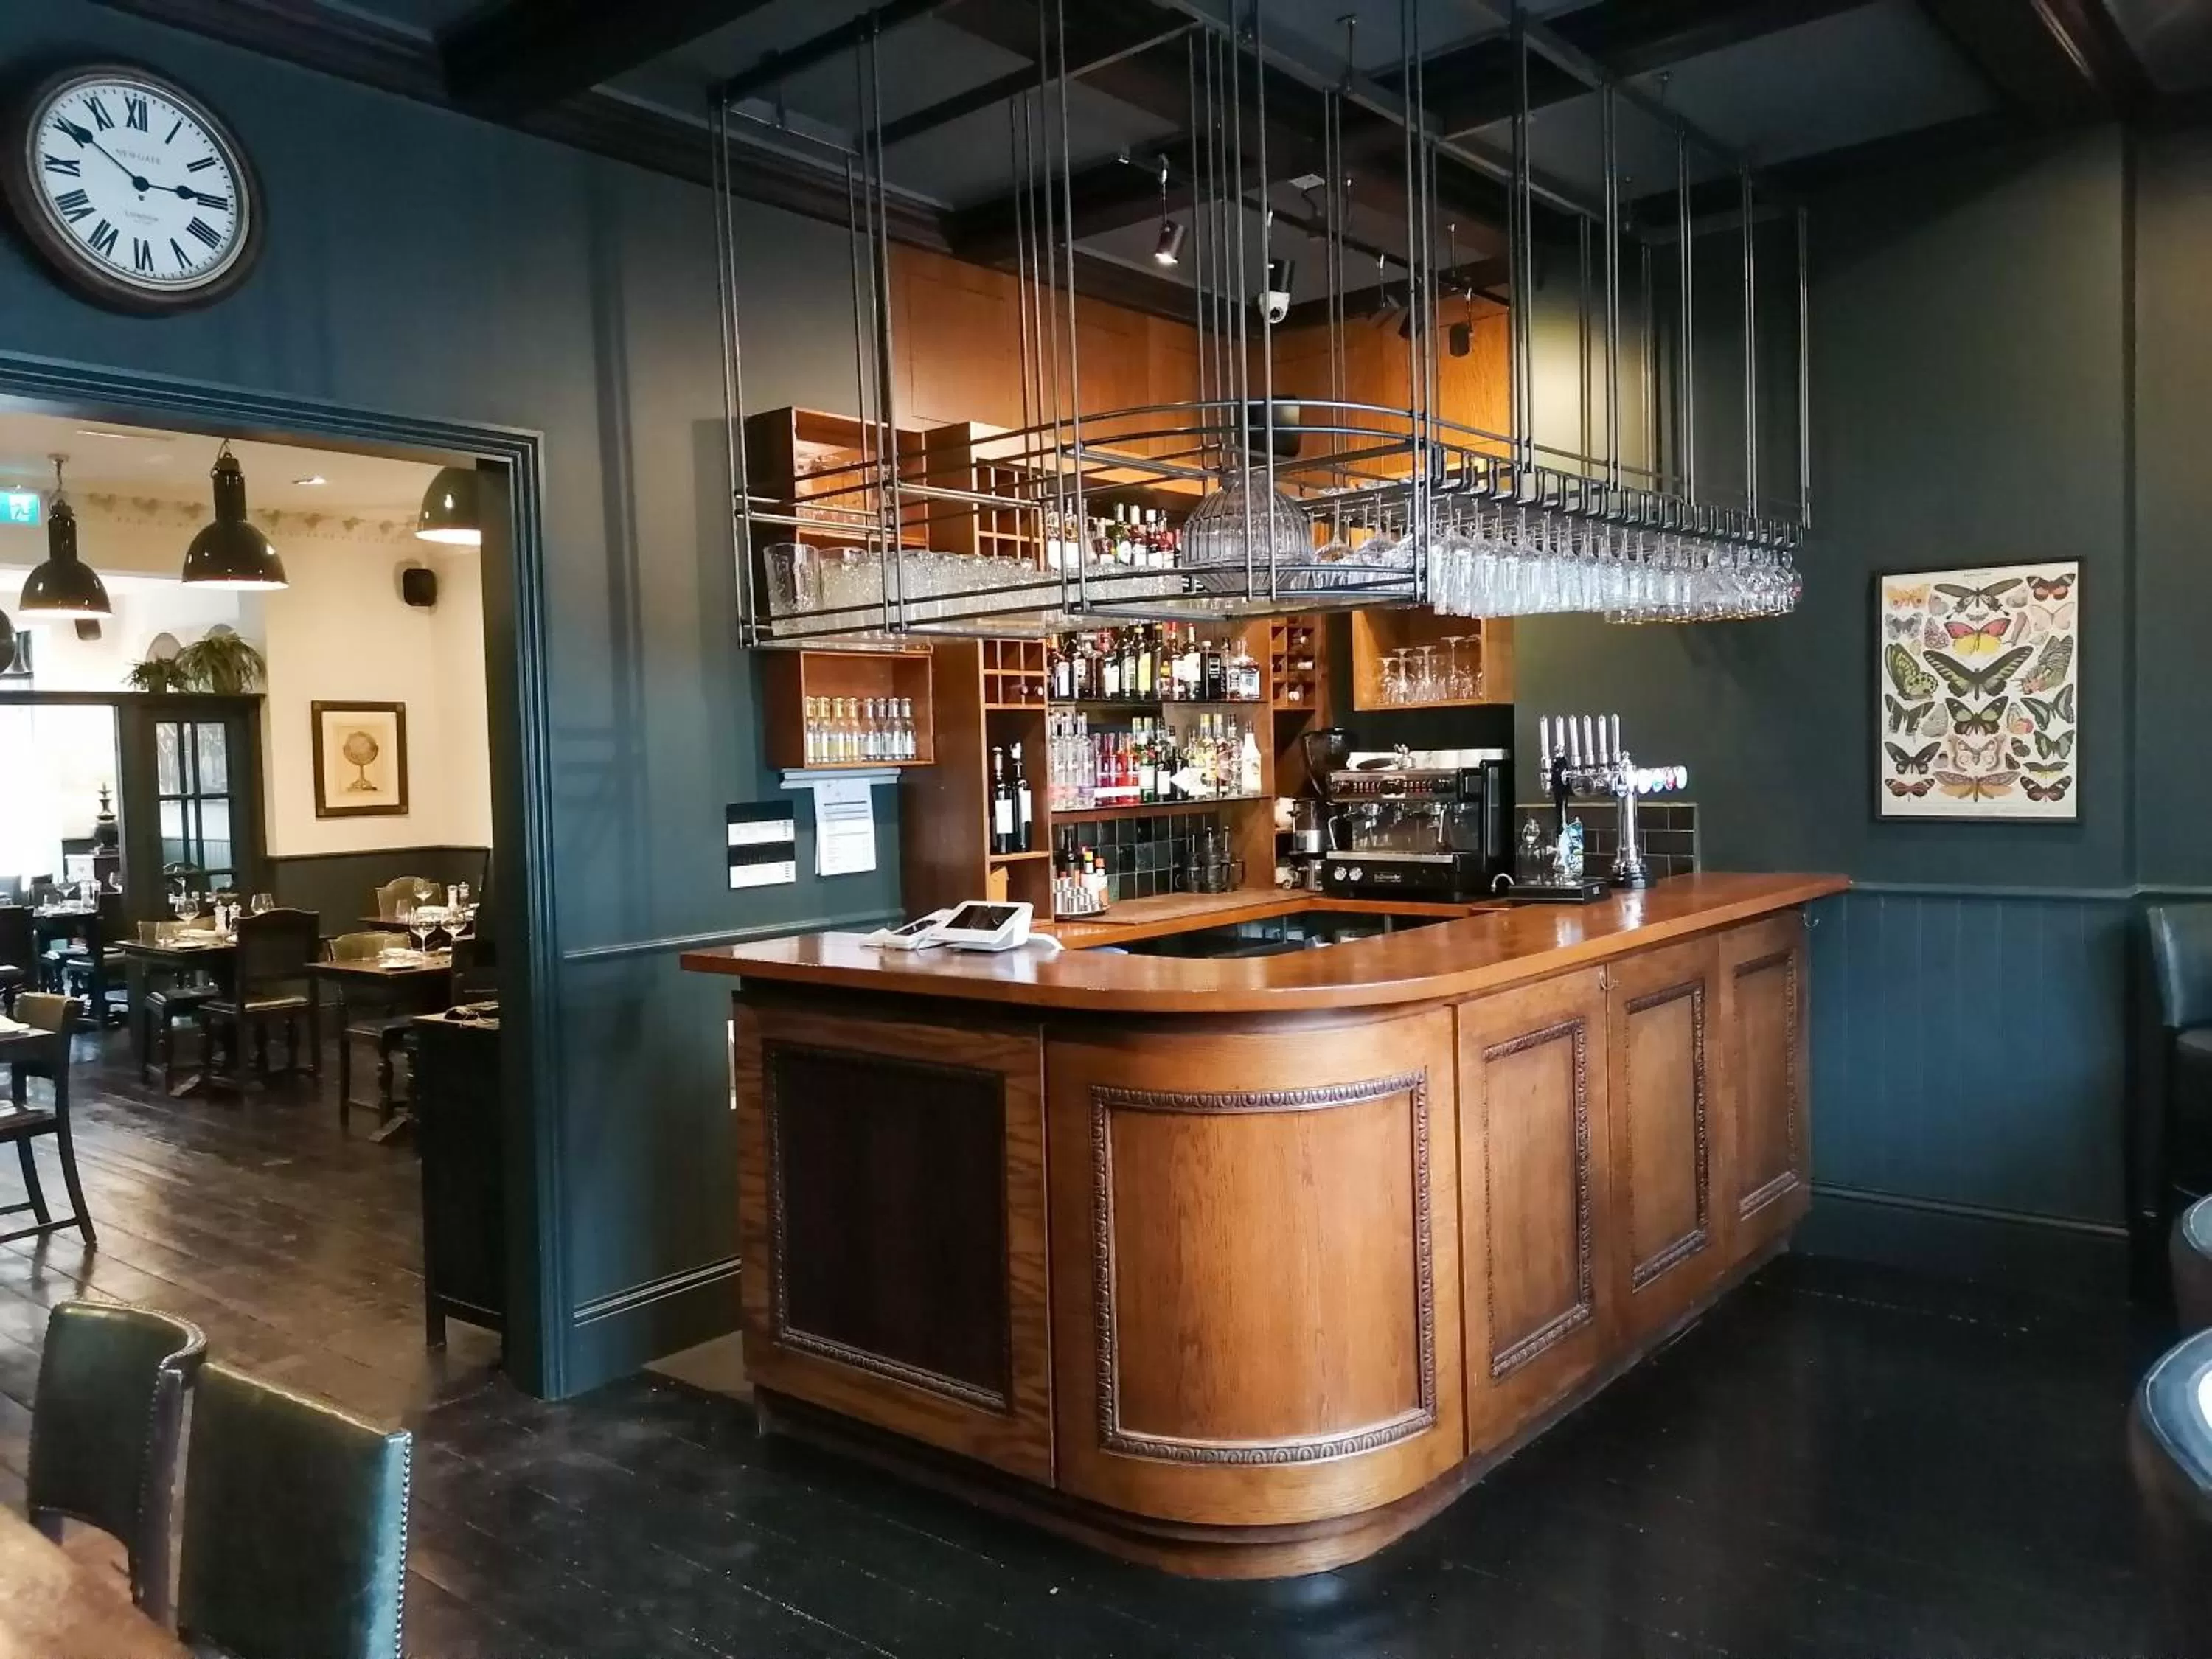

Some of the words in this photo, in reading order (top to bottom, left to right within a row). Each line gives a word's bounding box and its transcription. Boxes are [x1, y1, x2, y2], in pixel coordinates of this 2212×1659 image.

[83, 97, 115, 132] XI
[125, 96, 148, 133] XII
[164, 120, 183, 145] I
[44, 153, 80, 177] IX
[187, 156, 217, 173] II
[55, 189, 97, 224] VIII
[197, 192, 229, 212] III
[88, 219, 119, 257] VII
[186, 216, 222, 250] IIII
[133, 237, 154, 272] VI
[170, 237, 193, 270] V
